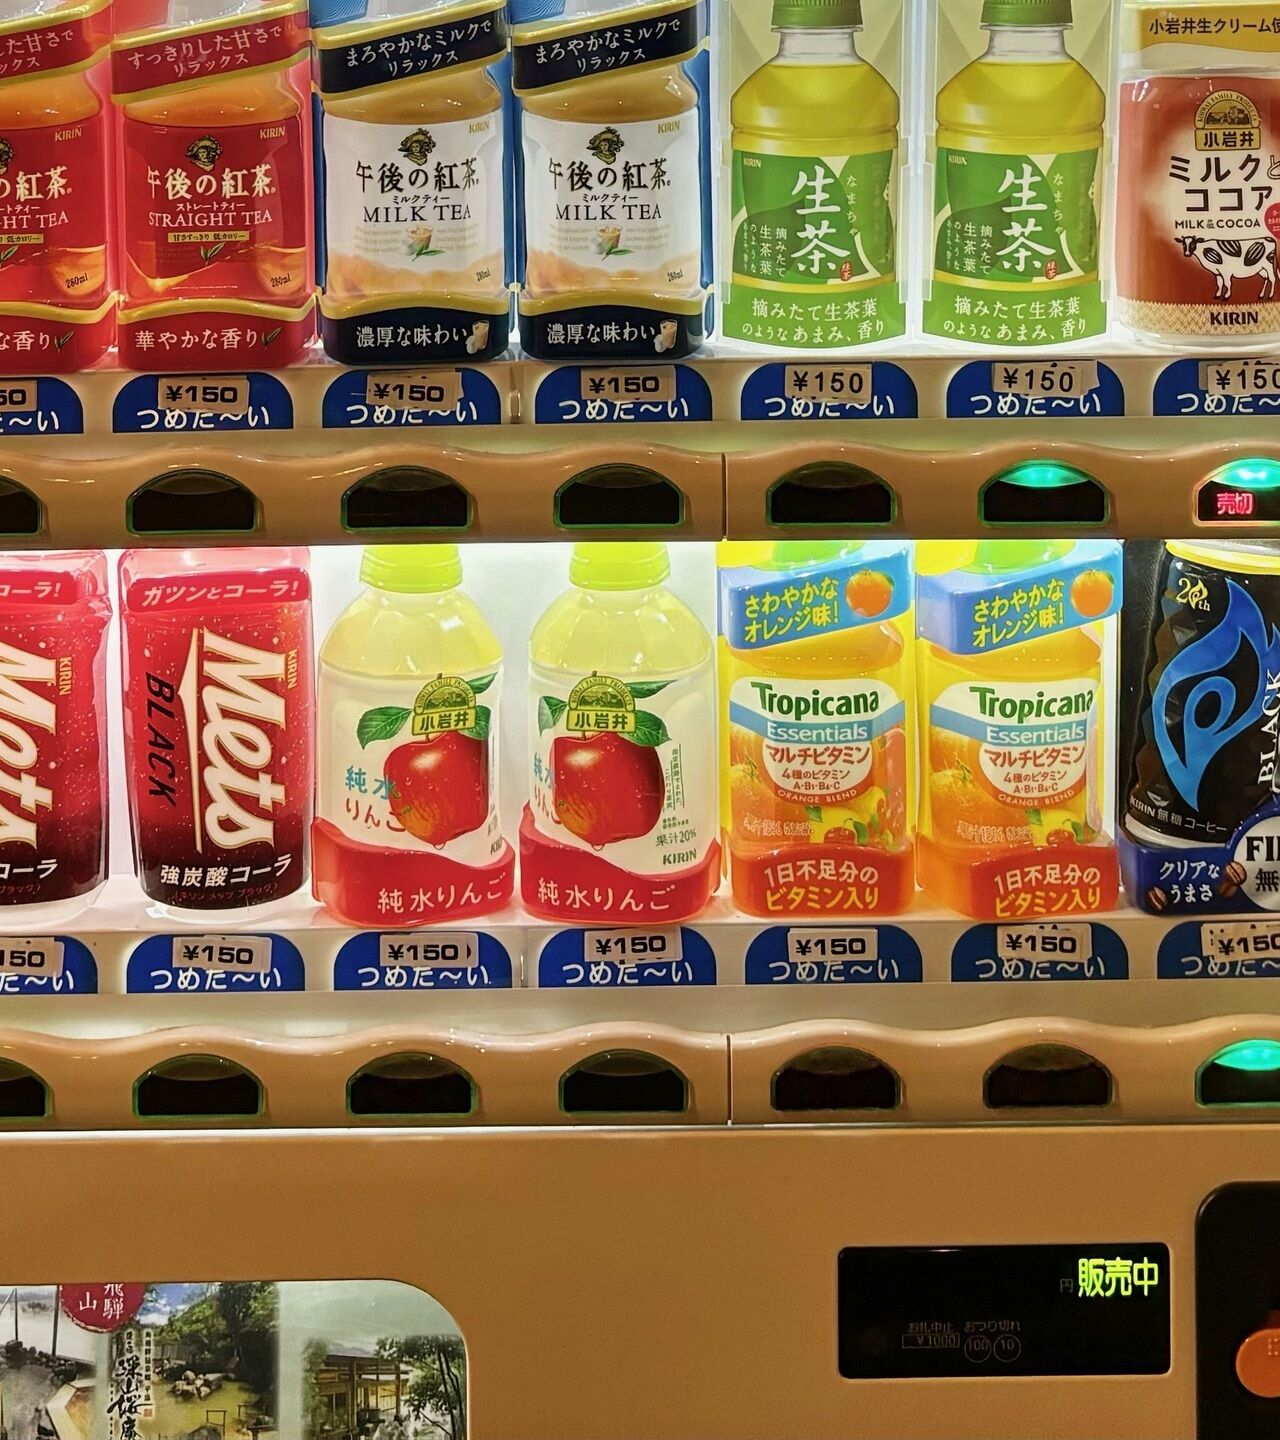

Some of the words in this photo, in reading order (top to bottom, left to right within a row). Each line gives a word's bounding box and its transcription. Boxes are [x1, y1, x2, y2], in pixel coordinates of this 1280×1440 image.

[346, 20, 491, 67] まろやかなミルクで
[388, 49, 458, 75] リラックス
[260, 126, 285, 139] KIRIN
[1204, 133, 1253, 147] 小岩井
[1186, 186, 1273, 212] ココア
[149, 212, 236, 227] STRAIGHT
[241, 210, 273, 225] TEA
[364, 205, 427, 223] MILK
[433, 205, 471, 221] TEA
[556, 203, 619, 221] MILK
[627, 203, 661, 220] TEA
[791, 165, 851, 274] 生茶
[996, 162, 1056, 272] 生茶
[1175, 219, 1205, 229] MILK
[1216, 219, 1260, 228] COCOA
[752, 297, 877, 321] 摘みたて生茶葉
[1210, 311, 1258, 325] KIRIN
[357, 326, 467, 347] 濃厚な味わい
[589, 377, 660, 394] ¥150
[794, 371, 864, 393] ¥150
[1217, 492, 1253, 515] 売切
[744, 577, 839, 618] さわやかな
[57, 657, 72, 696] KIRIN
[751, 682, 879, 721] Tropicana
[969, 686, 1094, 724] Tropicana
[574, 714, 629, 729] 小岩井
[145, 672, 176, 807] BLACK
[203, 626, 286, 850] Mets
[767, 723, 867, 742] Essentials
[986, 724, 1085, 743] Essentials
[766, 745, 872, 765] マルチビタミン
[777, 789, 819, 804] ORANGE
[826, 789, 857, 804] BLEND
[662, 850, 697, 865] KIRIN
[764, 859, 878, 887] 1日不足分の
[1160, 861, 1220, 881] クリアな
[377, 873, 506, 914] 純水りんご
[538, 878, 675, 911] 純水りんご
[766, 886, 879, 912] ビタミン入り
[1170, 884, 1213, 903] うまさ
[183, 945, 253, 964] ¥150
[796, 938, 866, 956] ¥150
[1078, 1257, 1158, 1297] 販売中
